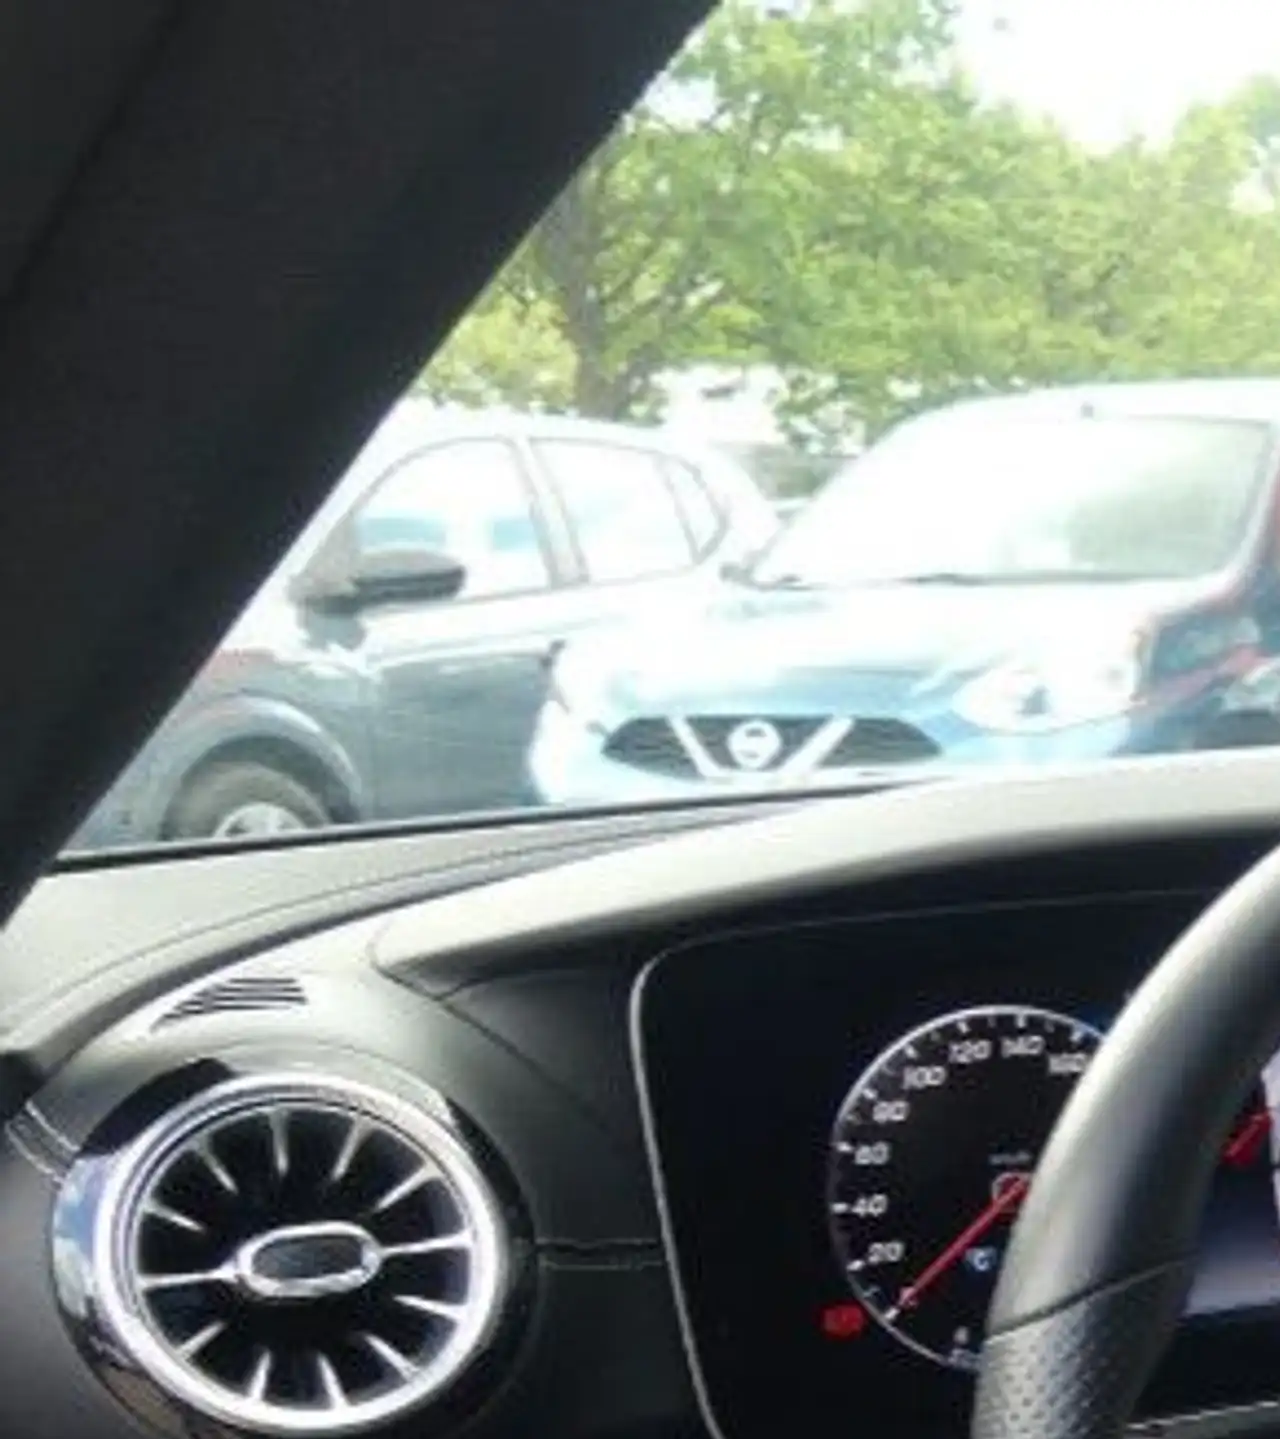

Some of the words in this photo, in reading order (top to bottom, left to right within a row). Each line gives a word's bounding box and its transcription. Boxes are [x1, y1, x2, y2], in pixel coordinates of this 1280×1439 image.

[903, 1065, 947, 1090] 100
[852, 1193, 889, 1217] 40
[868, 1241, 905, 1264] 20
